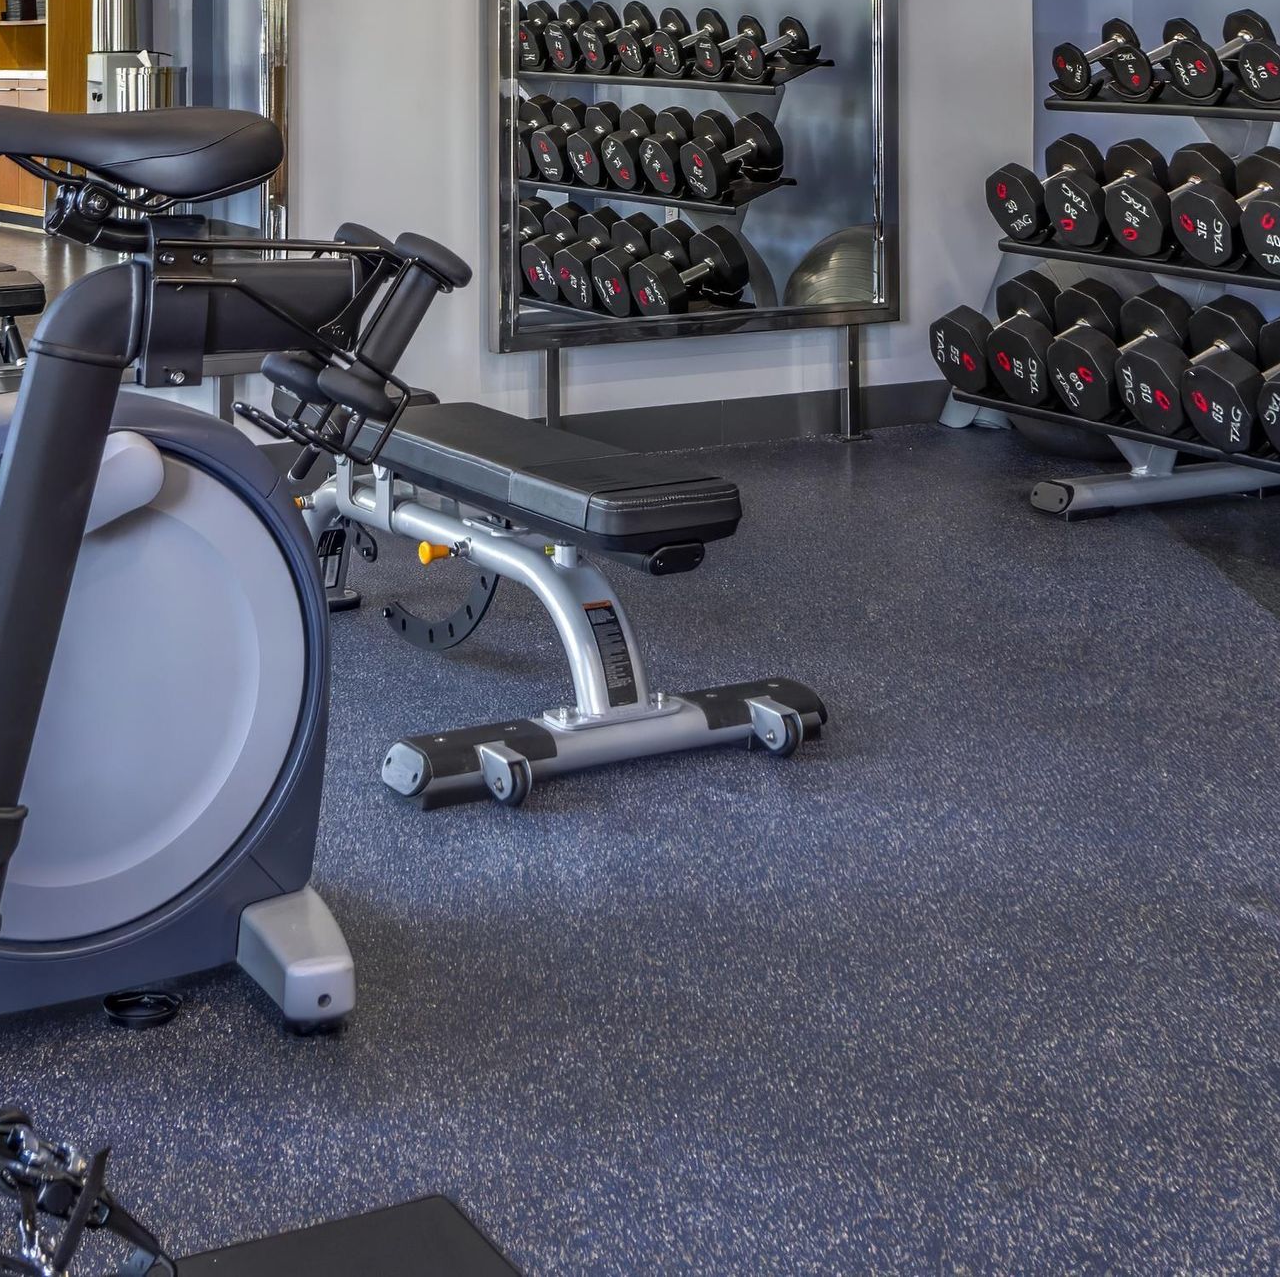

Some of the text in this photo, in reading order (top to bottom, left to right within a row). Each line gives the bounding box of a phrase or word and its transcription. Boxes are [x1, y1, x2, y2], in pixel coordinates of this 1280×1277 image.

[1117, 53, 1137, 62] TAG
[1128, 64, 1133, 73] 5
[1174, 58, 1190, 86] TAG
[1186, 63, 1197, 76] 10
[1244, 59, 1260, 89] TAG
[1257, 65, 1268, 79] 10
[1061, 184, 1088, 212] TAG
[1120, 191, 1150, 218] TAG
[1064, 203, 1077, 219] 30
[1124, 211, 1140, 228] 35
[1010, 214, 1033, 231] TAG
[1214, 218, 1224, 254] TAG
[935, 330, 945, 363] TAG
[950, 345, 960, 365] 55
[1013, 358, 1023, 378] 55
[1029, 358, 1039, 394] TAG
[1055, 368, 1079, 407] TAG
[1069, 372, 1084, 390] 60
[1121, 366, 1135, 405] TAG
[1212, 402, 1224, 423] 65
[1230, 406, 1242, 442] TAG
